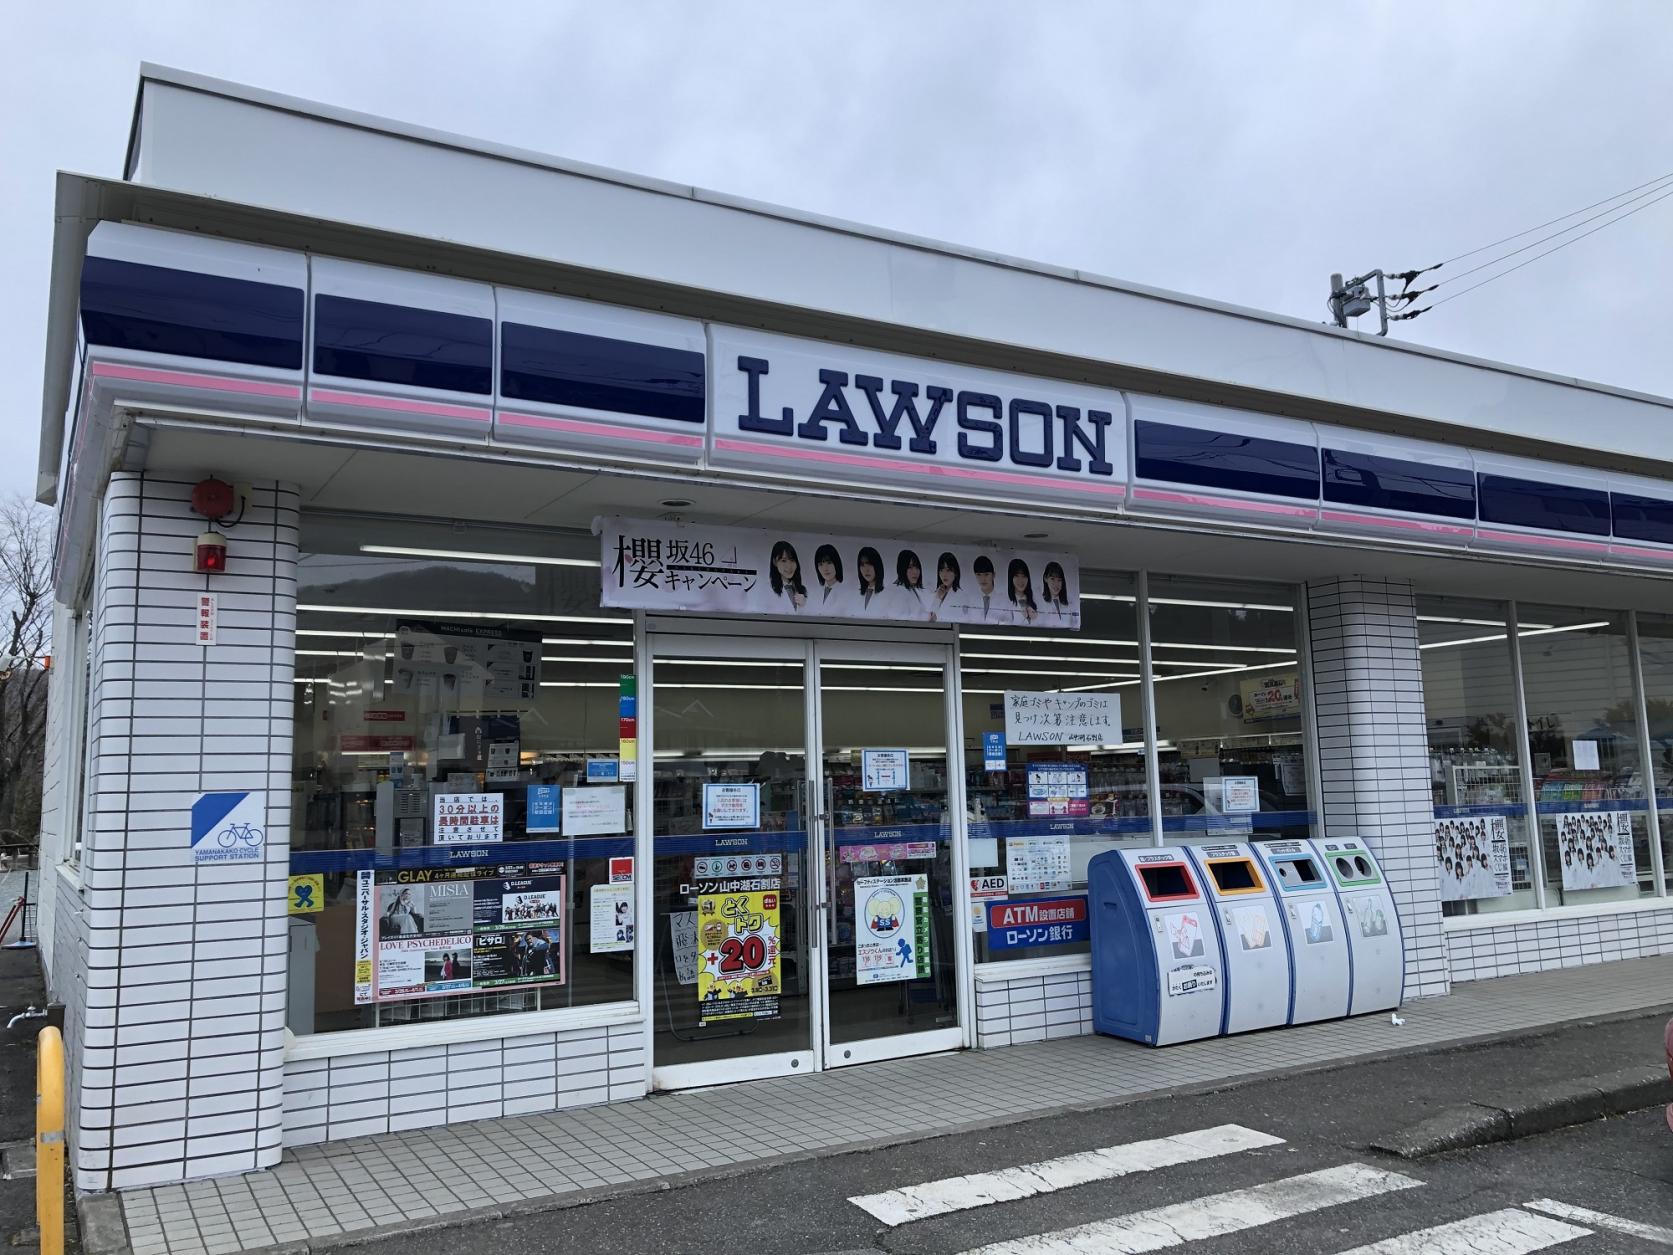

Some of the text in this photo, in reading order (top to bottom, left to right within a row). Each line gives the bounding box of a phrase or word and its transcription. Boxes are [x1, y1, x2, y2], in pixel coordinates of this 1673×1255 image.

[737, 355, 1113, 476] LAWSON
[665, 570, 757, 593] キャンペーン
[200, 597, 210, 640] 警報装置
[1018, 731, 1064, 742] LAWSON
[439, 803, 499, 814] 30分以上の
[438, 815, 499, 826] 長時間駐車は
[874, 830, 902, 838] LAWSON
[715, 838, 748, 847] LAWSON
[195, 848, 239, 856] YAMANAKAKO
[450, 849, 489, 859] LAWSON
[397, 870, 433, 883] GLAY
[982, 878, 1005, 890] AED
[429, 883, 469, 898] MISIA
[679, 878, 781, 895] ローソン山中湖石割店
[720, 896, 750, 918] とく
[1003, 905, 1075, 925] ATM 設置店舗
[734, 913, 764, 935] トク
[1006, 925, 1073, 945] ローソン銀行
[380, 936, 472, 951] LOVE PSYCHEDELICO
